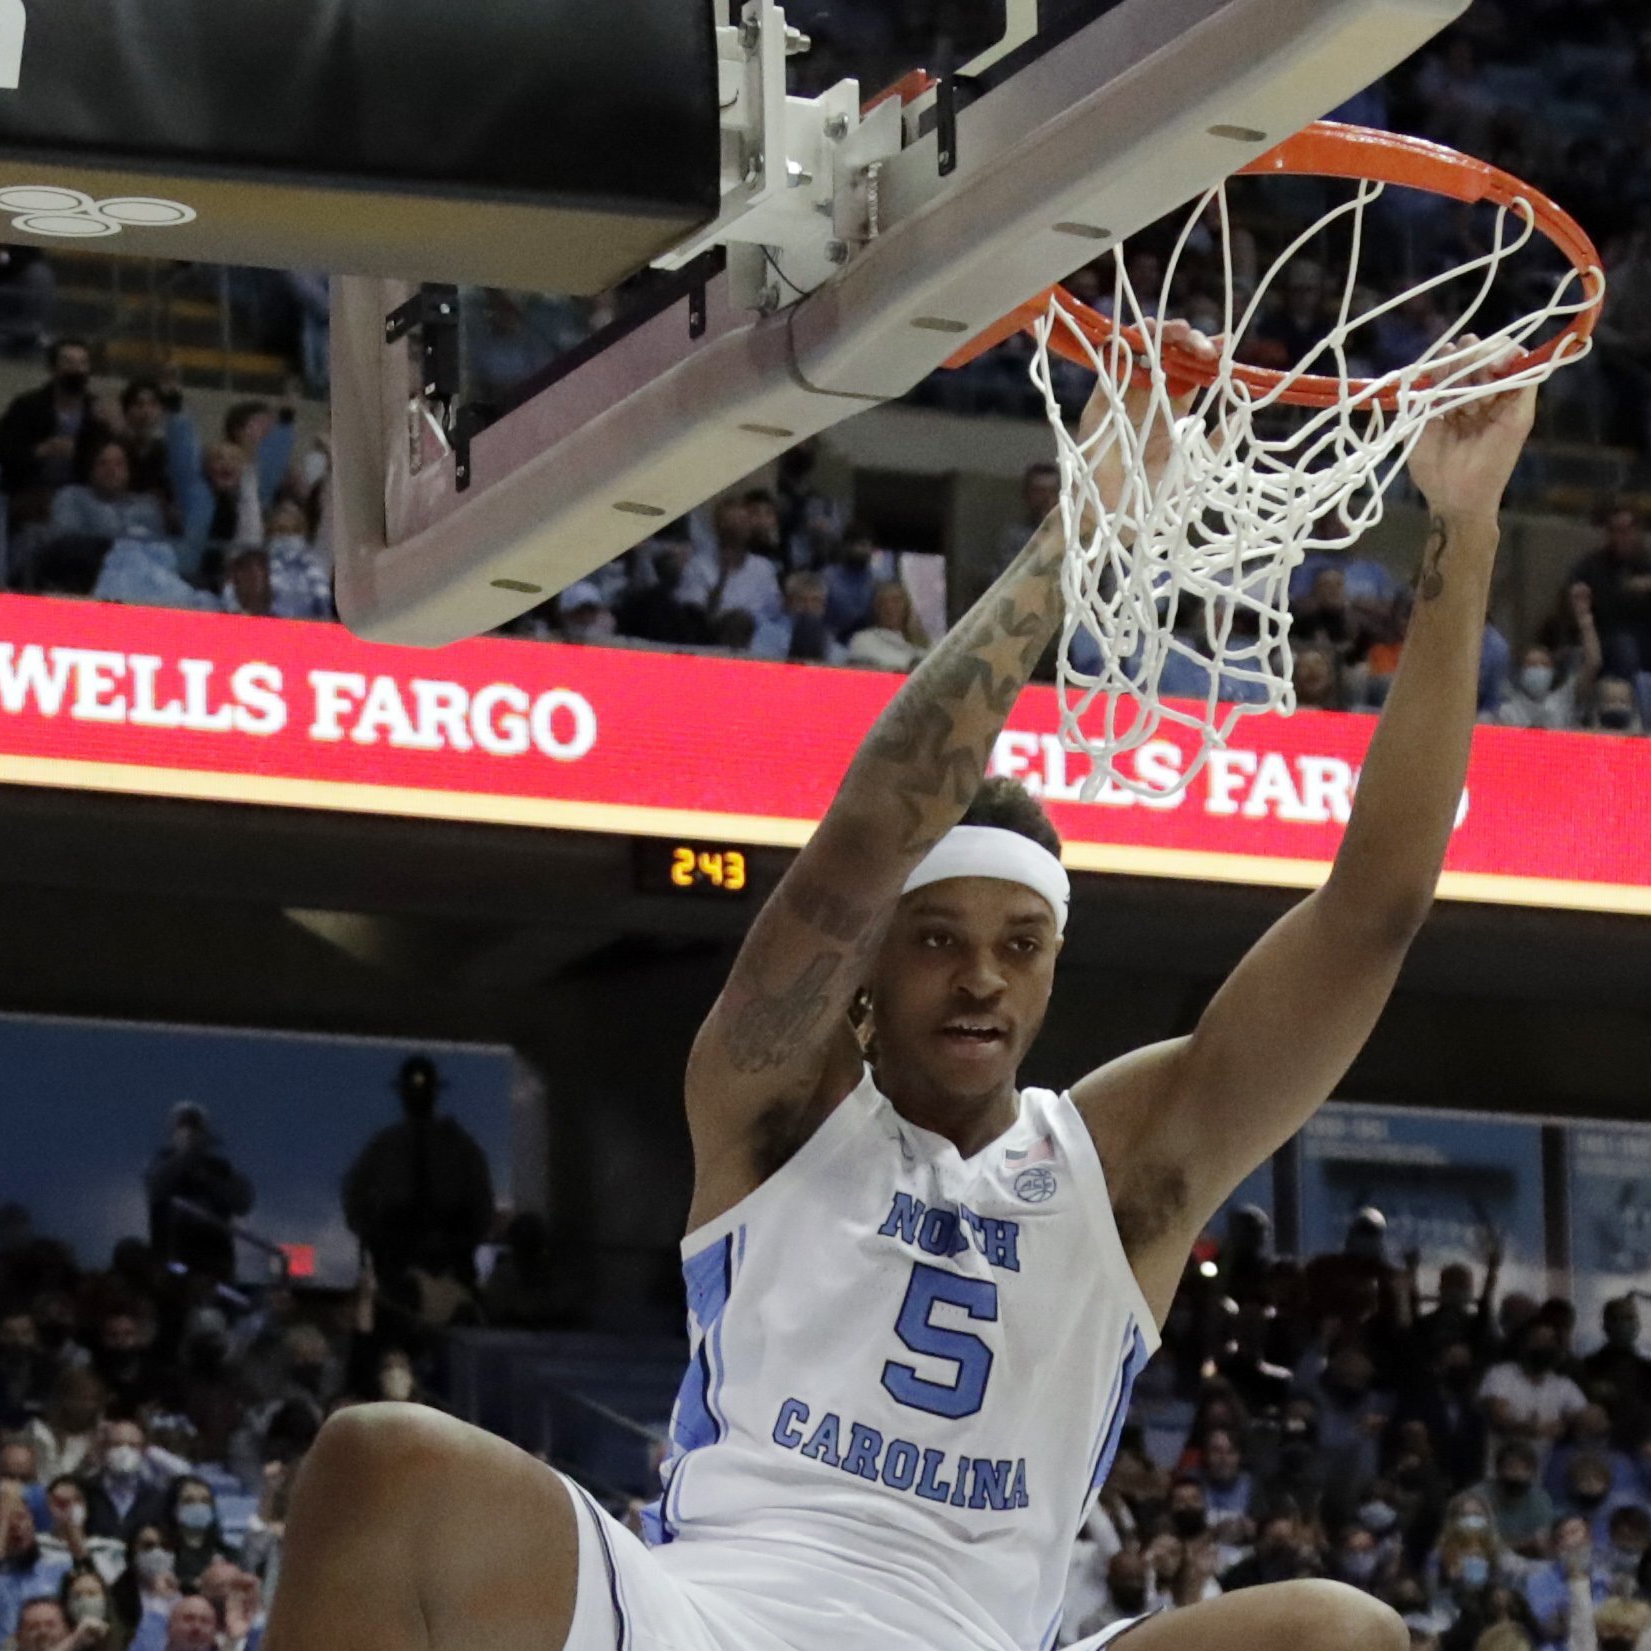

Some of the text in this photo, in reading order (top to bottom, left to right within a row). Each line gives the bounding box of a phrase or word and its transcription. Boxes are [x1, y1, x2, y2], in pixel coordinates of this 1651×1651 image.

[308, 670, 597, 760] FARGO
[989, 731, 1186, 808] ELLS
[880, 1261, 998, 1420] 5
[772, 1397, 1029, 1511] CAROLINA
